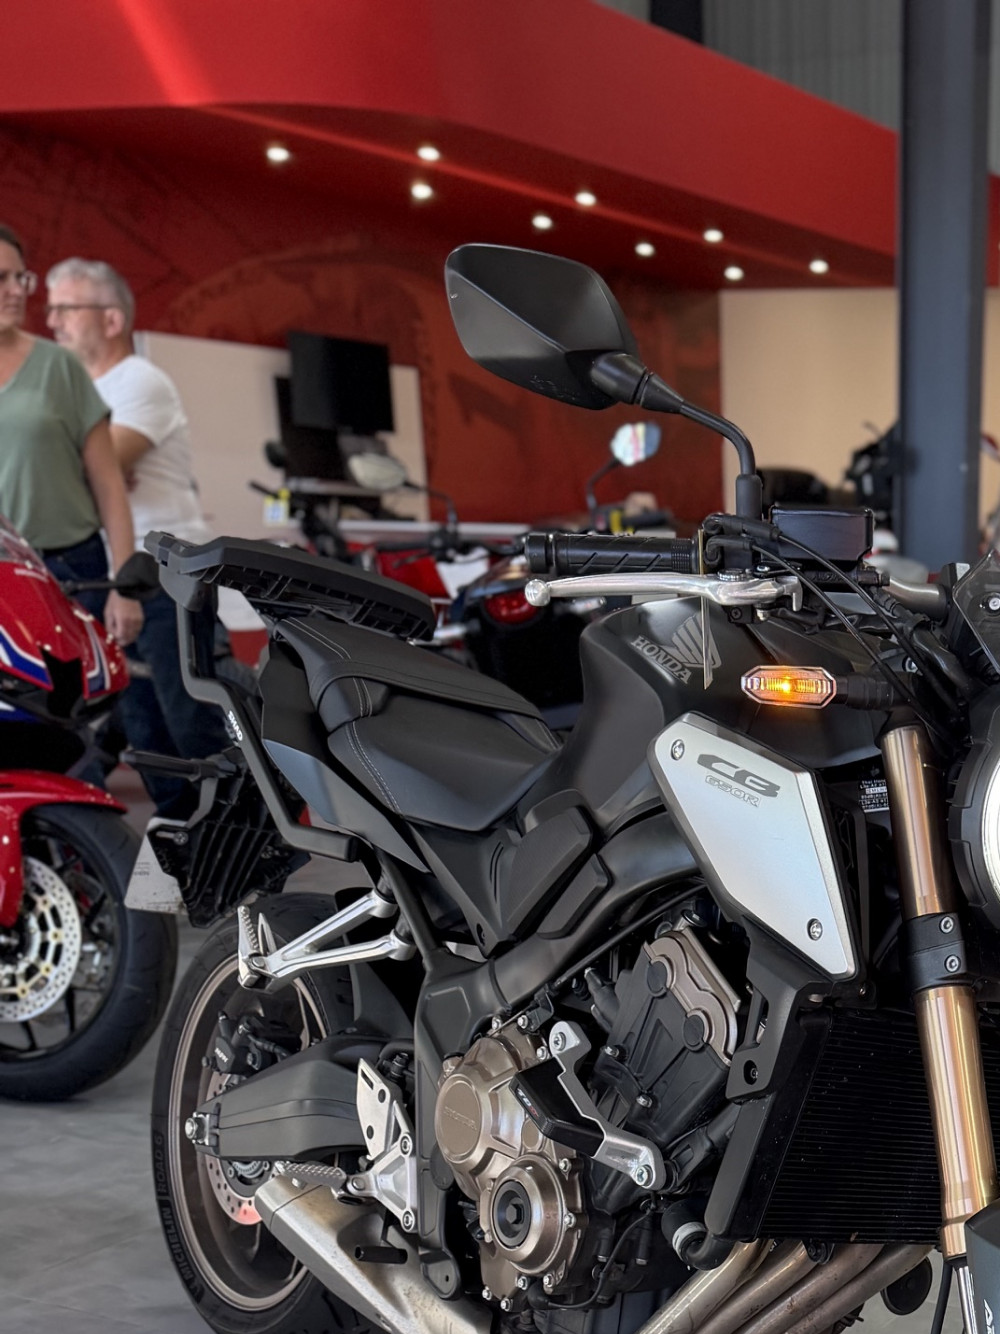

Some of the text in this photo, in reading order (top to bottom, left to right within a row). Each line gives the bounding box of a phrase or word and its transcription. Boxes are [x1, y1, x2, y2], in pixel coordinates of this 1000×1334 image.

[630, 635, 692, 684] HONDA
[228, 710, 243, 741] SHAD
[697, 754, 781, 798] CB
[705, 775, 760, 808] 650R
[154, 1134, 194, 1281] MICHELIN ROAD 6
